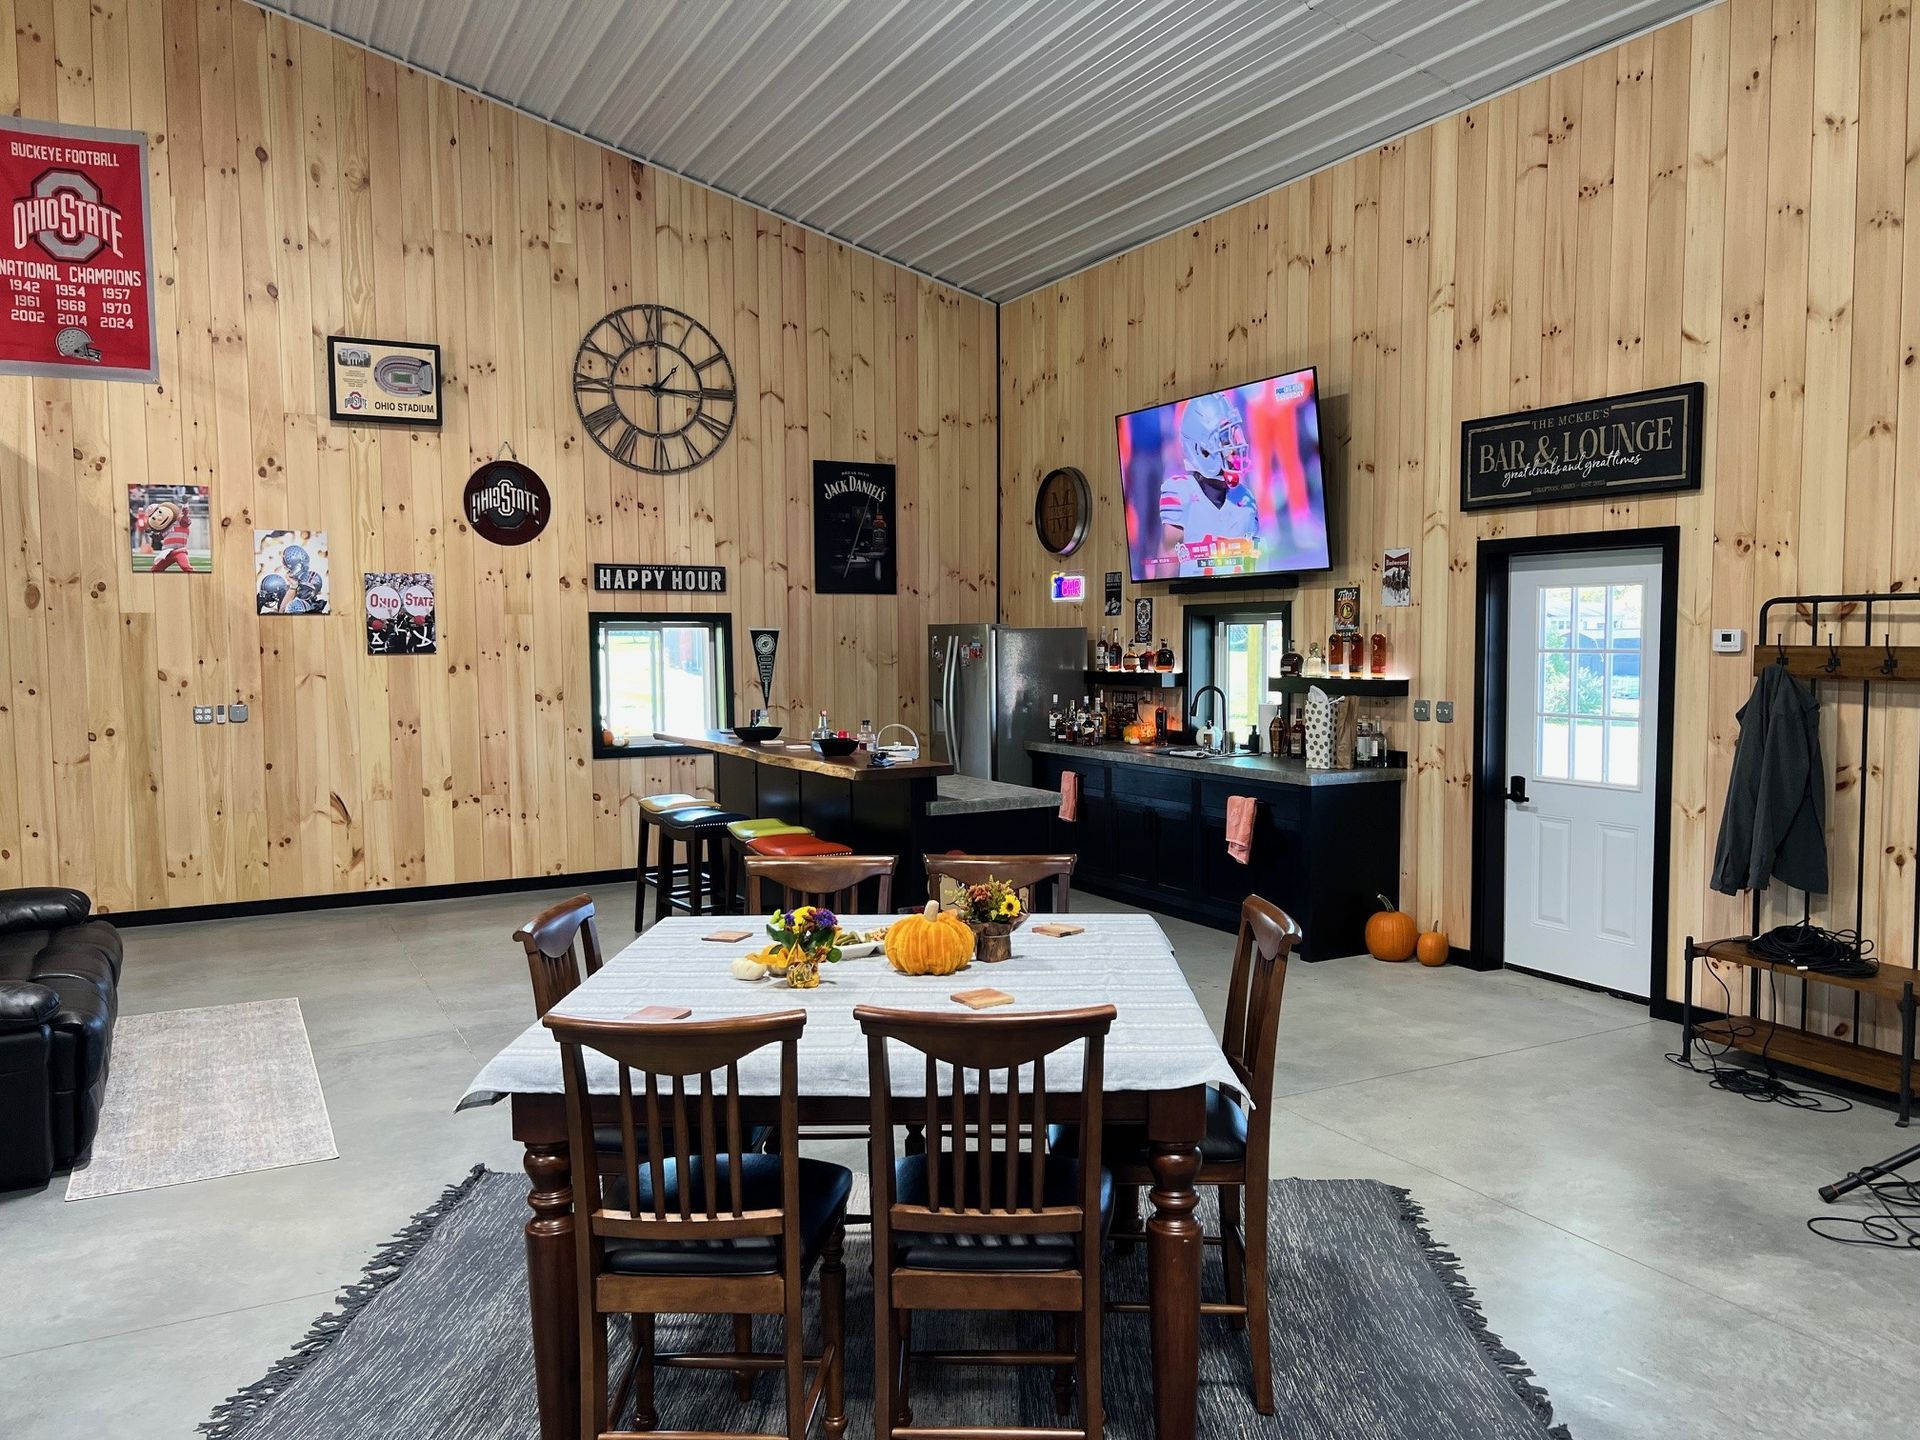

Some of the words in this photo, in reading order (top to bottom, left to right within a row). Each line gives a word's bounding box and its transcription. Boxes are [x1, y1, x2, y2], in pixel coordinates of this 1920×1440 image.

[11, 142, 63, 162] BUCKEYE
[65, 148, 119, 167] FOOTBALL
[13, 198, 59, 249] OHIO
[60, 193, 124, 259] STATE
[0, 258, 61, 281] NATIONAL
[69, 266, 141, 287] CHAMPIONS
[9, 279, 40, 293] 1942
[55, 284, 85, 297] 1954
[102, 287, 130, 300] 1957
[15, 294, 40, 307] 1961
[56, 298, 86, 312] 1968
[102, 302, 131, 315] 1970
[11, 309, 45, 323] 2002
[57, 313, 87, 327] 2014
[100, 316, 133, 329] 2024
[374, 401, 396, 411] OHIO
[397, 403, 434, 413] STADIUM
[1532, 418, 1555, 430] THE
[1558, 408, 1610, 426] MCKEE'S
[1479, 439, 1526, 474] BAR
[1533, 435, 1558, 467] &
[1563, 416, 1673, 463] LOUNGE
[1502, 462, 1531, 488] great
[1528, 455, 1561, 476] drinks
[1562, 451, 1585, 472] and
[1582, 450, 1614, 478] great
[1612, 449, 1642, 467] times
[824, 480, 848, 500] JACK
[849, 475, 887, 502] DANIEL'S
[472, 486, 500, 523] OHIO
[500, 482, 540, 526] STATE
[599, 568, 665, 590] HAPPY
[671, 570, 722, 591] HOUR
[1062, 579, 1082, 596] BAR
[405, 592, 434, 607] STATE
